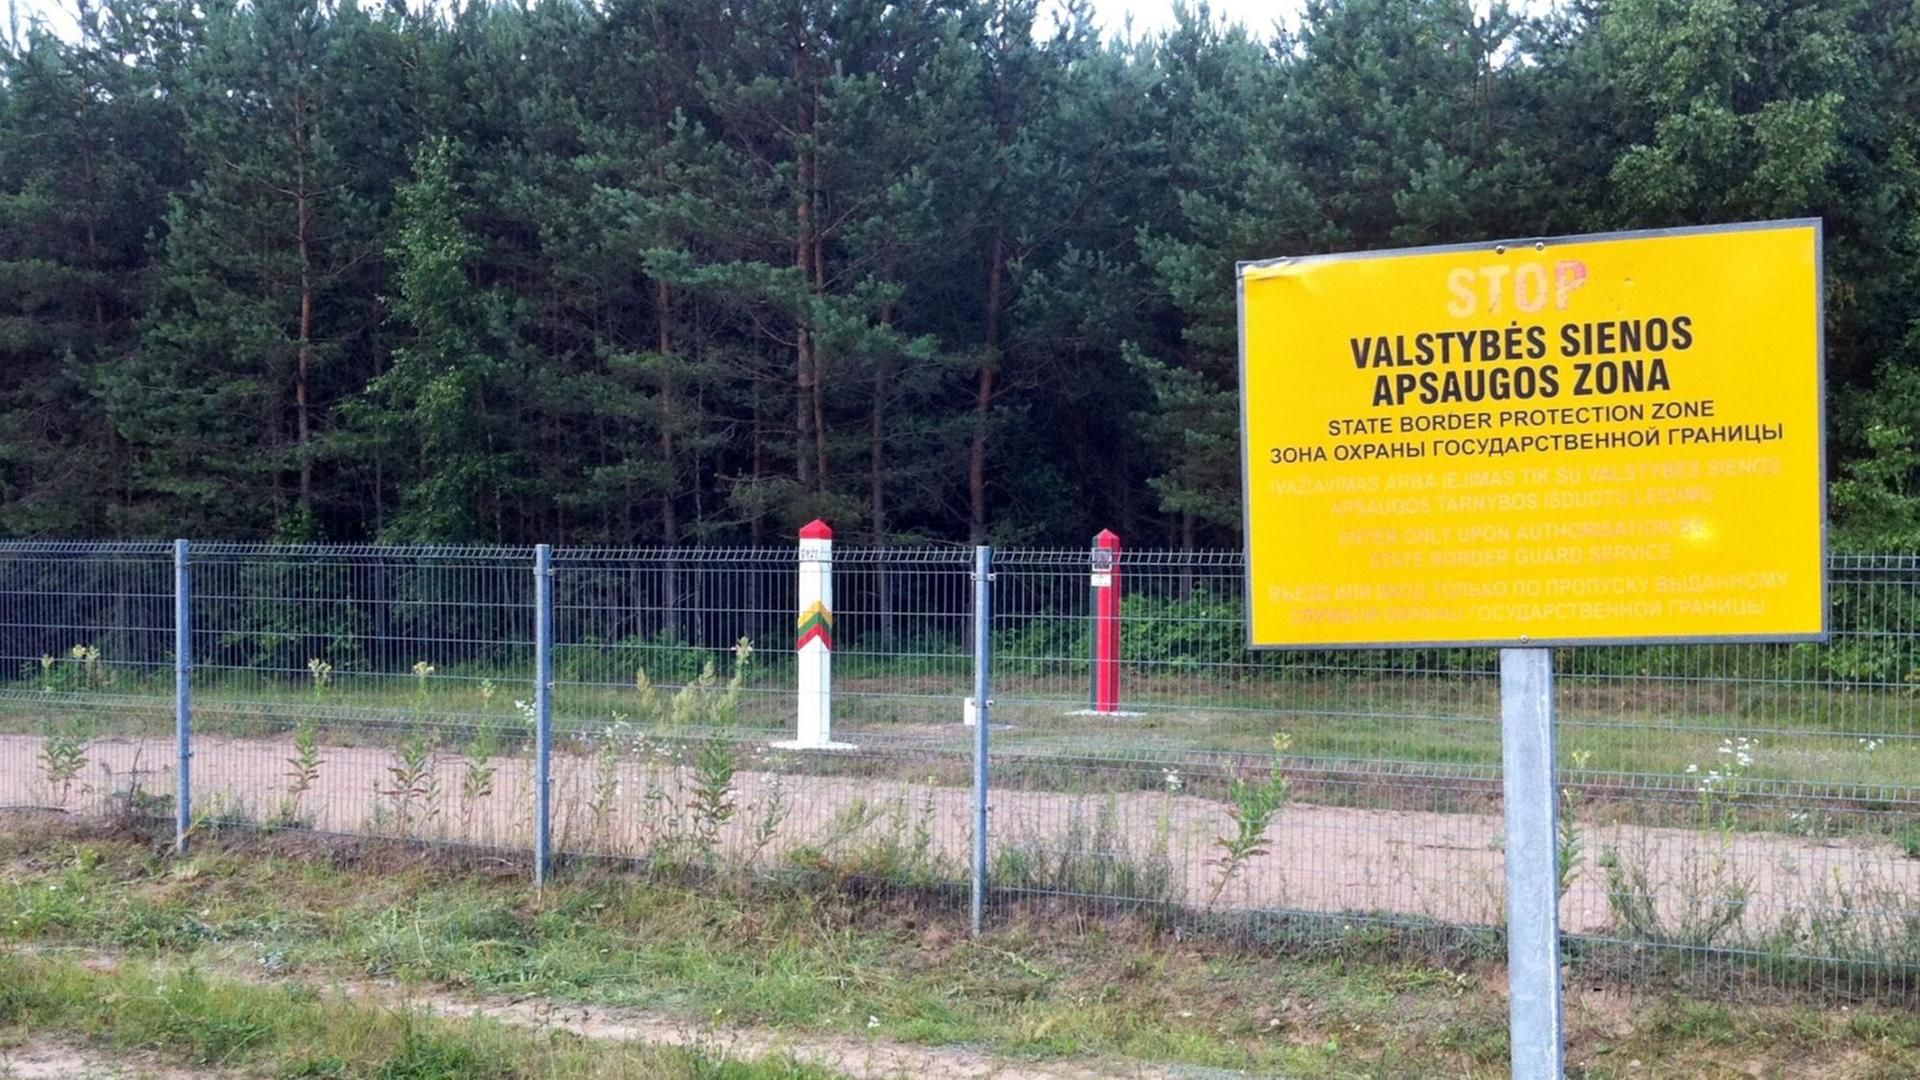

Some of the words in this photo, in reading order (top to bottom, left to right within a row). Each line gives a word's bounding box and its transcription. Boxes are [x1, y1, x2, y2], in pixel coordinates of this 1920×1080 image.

[1447, 260, 1587, 318] STOP
[1350, 319, 1546, 369] VALSTYBĖS
[1560, 316, 1693, 357] SIENOS
[1372, 365, 1560, 407] APSAUGOS
[1573, 358, 1671, 397] ZONA
[1271, 446, 1327, 464] ЗОНА
[1334, 440, 1426, 463] ОХРАНЫ
[1433, 425, 1660, 457] ГОСУДАРСТВЕННОЙ
[1668, 422, 1783, 446] ГРАНИЦЫ
[1328, 417, 1393, 437] STATE
[1400, 411, 1492, 434] BORDER
[1500, 404, 1645, 428] PROTECTION
[1651, 400, 1714, 421] ZONE
